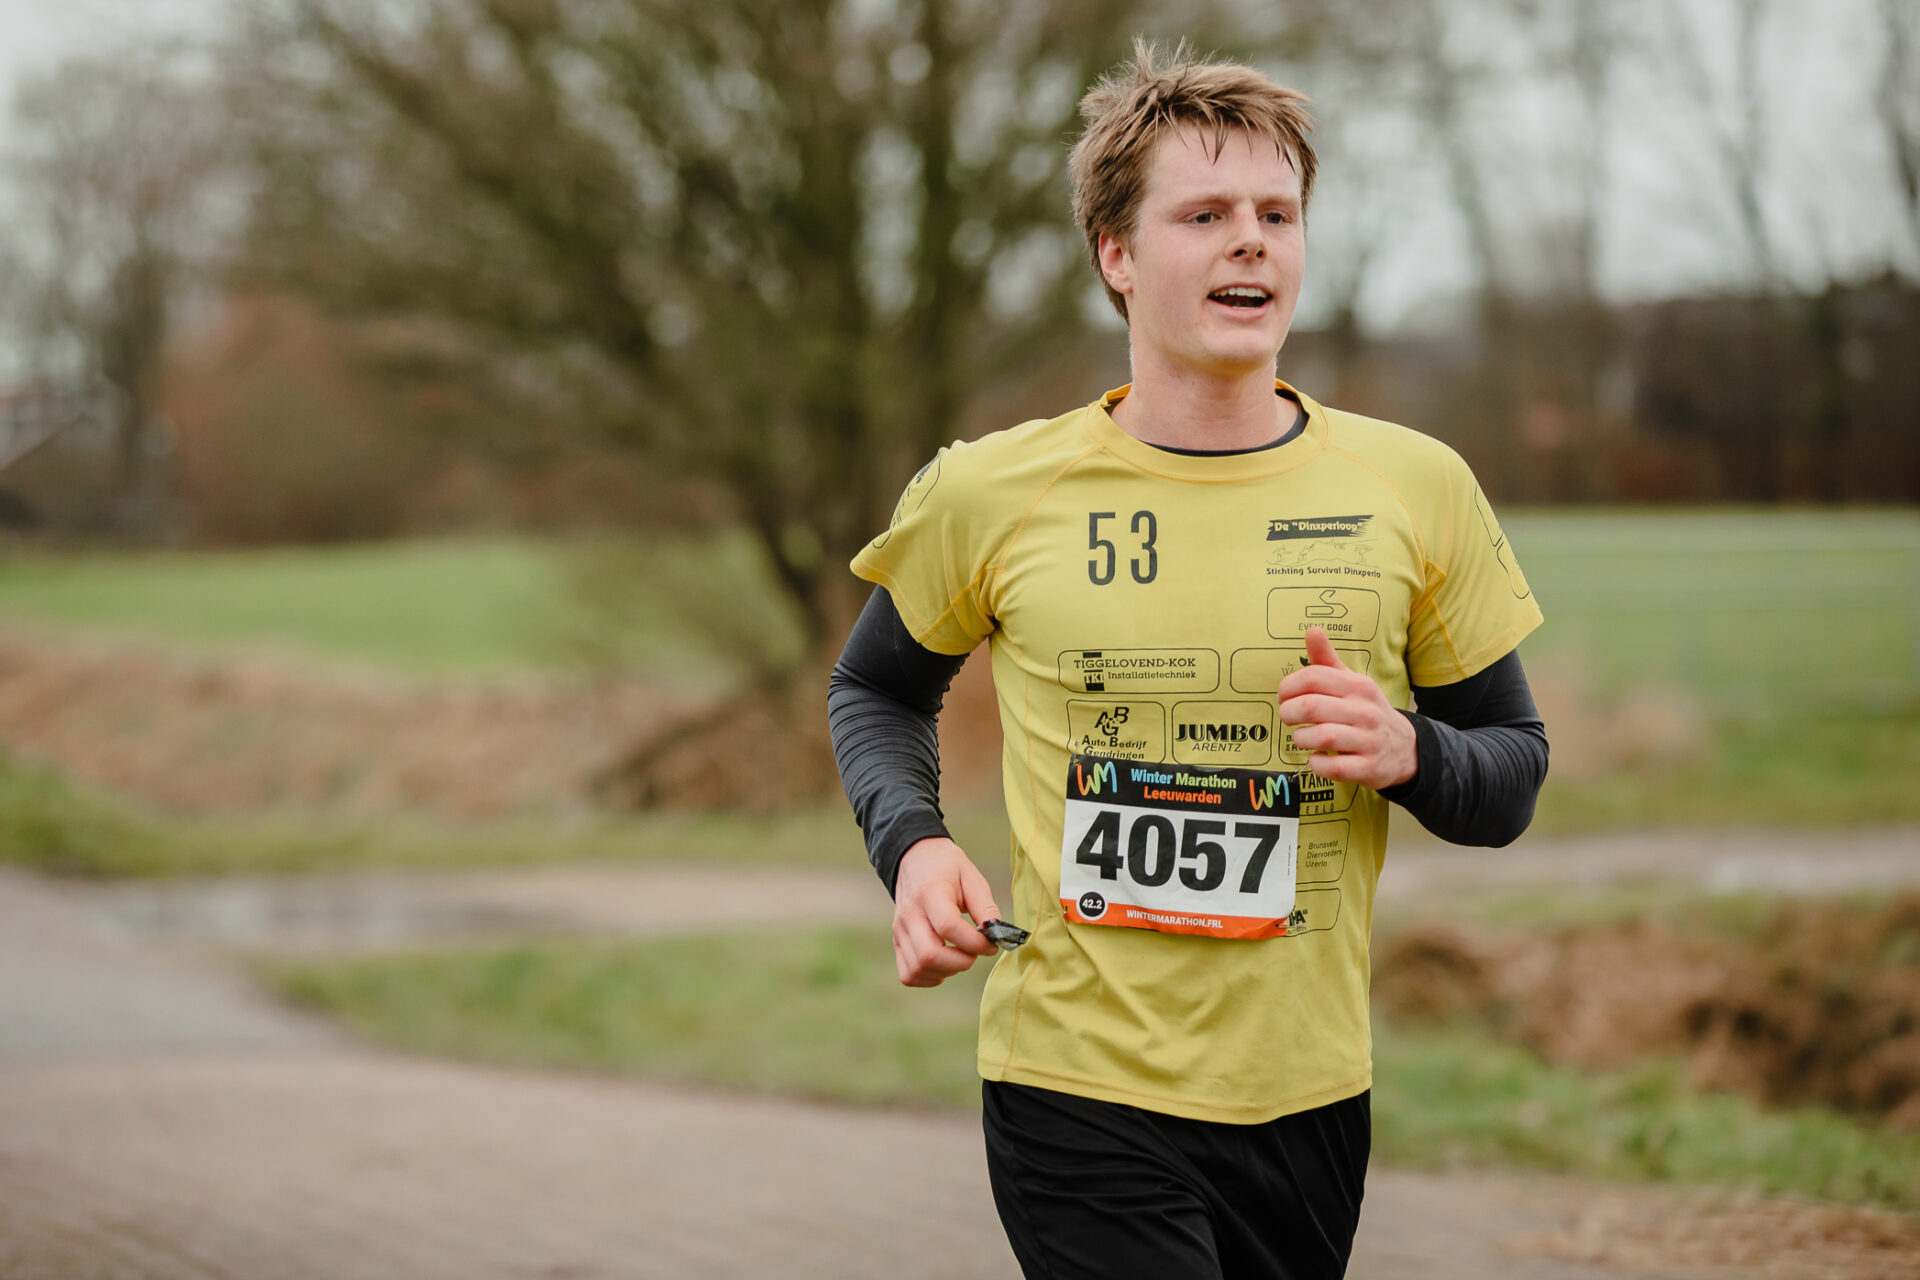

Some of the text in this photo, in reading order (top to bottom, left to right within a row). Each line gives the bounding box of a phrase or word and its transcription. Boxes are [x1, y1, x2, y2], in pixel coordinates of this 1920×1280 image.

[1274, 522, 1289, 531] De
[1088, 510, 1158, 586] 53
[1266, 567, 1304, 576] Stichting
[1307, 566, 1341, 575] Survival
[1327, 623, 1353, 633] GOOSE
[1074, 658, 1197, 669] TIGGELOVEND-KOK
[1107, 671, 1197, 680] Installatietechniek
[1175, 724, 1270, 743] JUMBO
[1082, 734, 1147, 750] Auto Bedrijf
[1192, 742, 1243, 753] ARENTZ
[1083, 745, 1145, 760] Gendringen
[1130, 767, 1237, 790] Winter Marathon
[1143, 786, 1222, 805] Leeuwarden
[1075, 810, 1281, 894] 4057
[1081, 898, 1103, 910] 42.2
[1126, 908, 1224, 929] WINTERMARATHON.FRL
